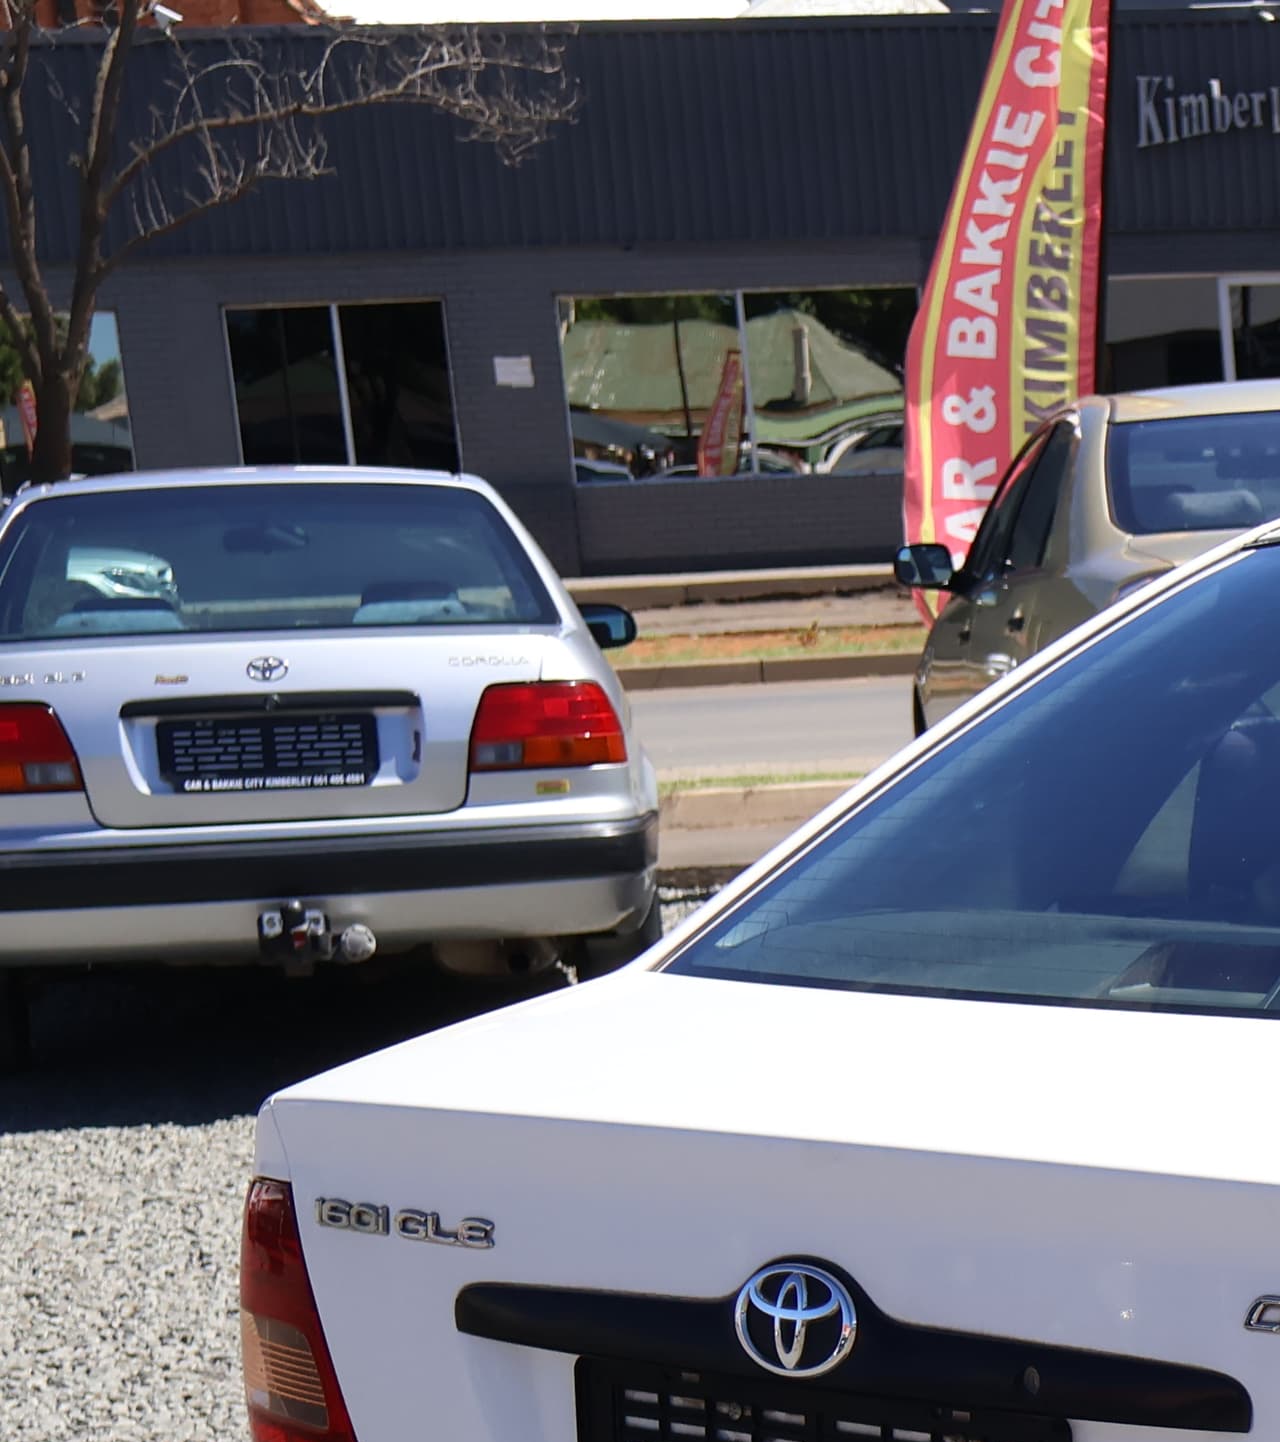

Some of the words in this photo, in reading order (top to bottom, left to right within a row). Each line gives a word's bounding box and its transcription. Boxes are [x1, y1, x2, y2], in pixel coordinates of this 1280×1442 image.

[945, 104, 1047, 360] BAKKIE
[941, 385, 997, 434] &
[942, 457, 998, 573] AR
[184, 778, 202, 791] CAR
[244, 776, 264, 789] CITY
[394, 1208, 496, 1250] GLE
